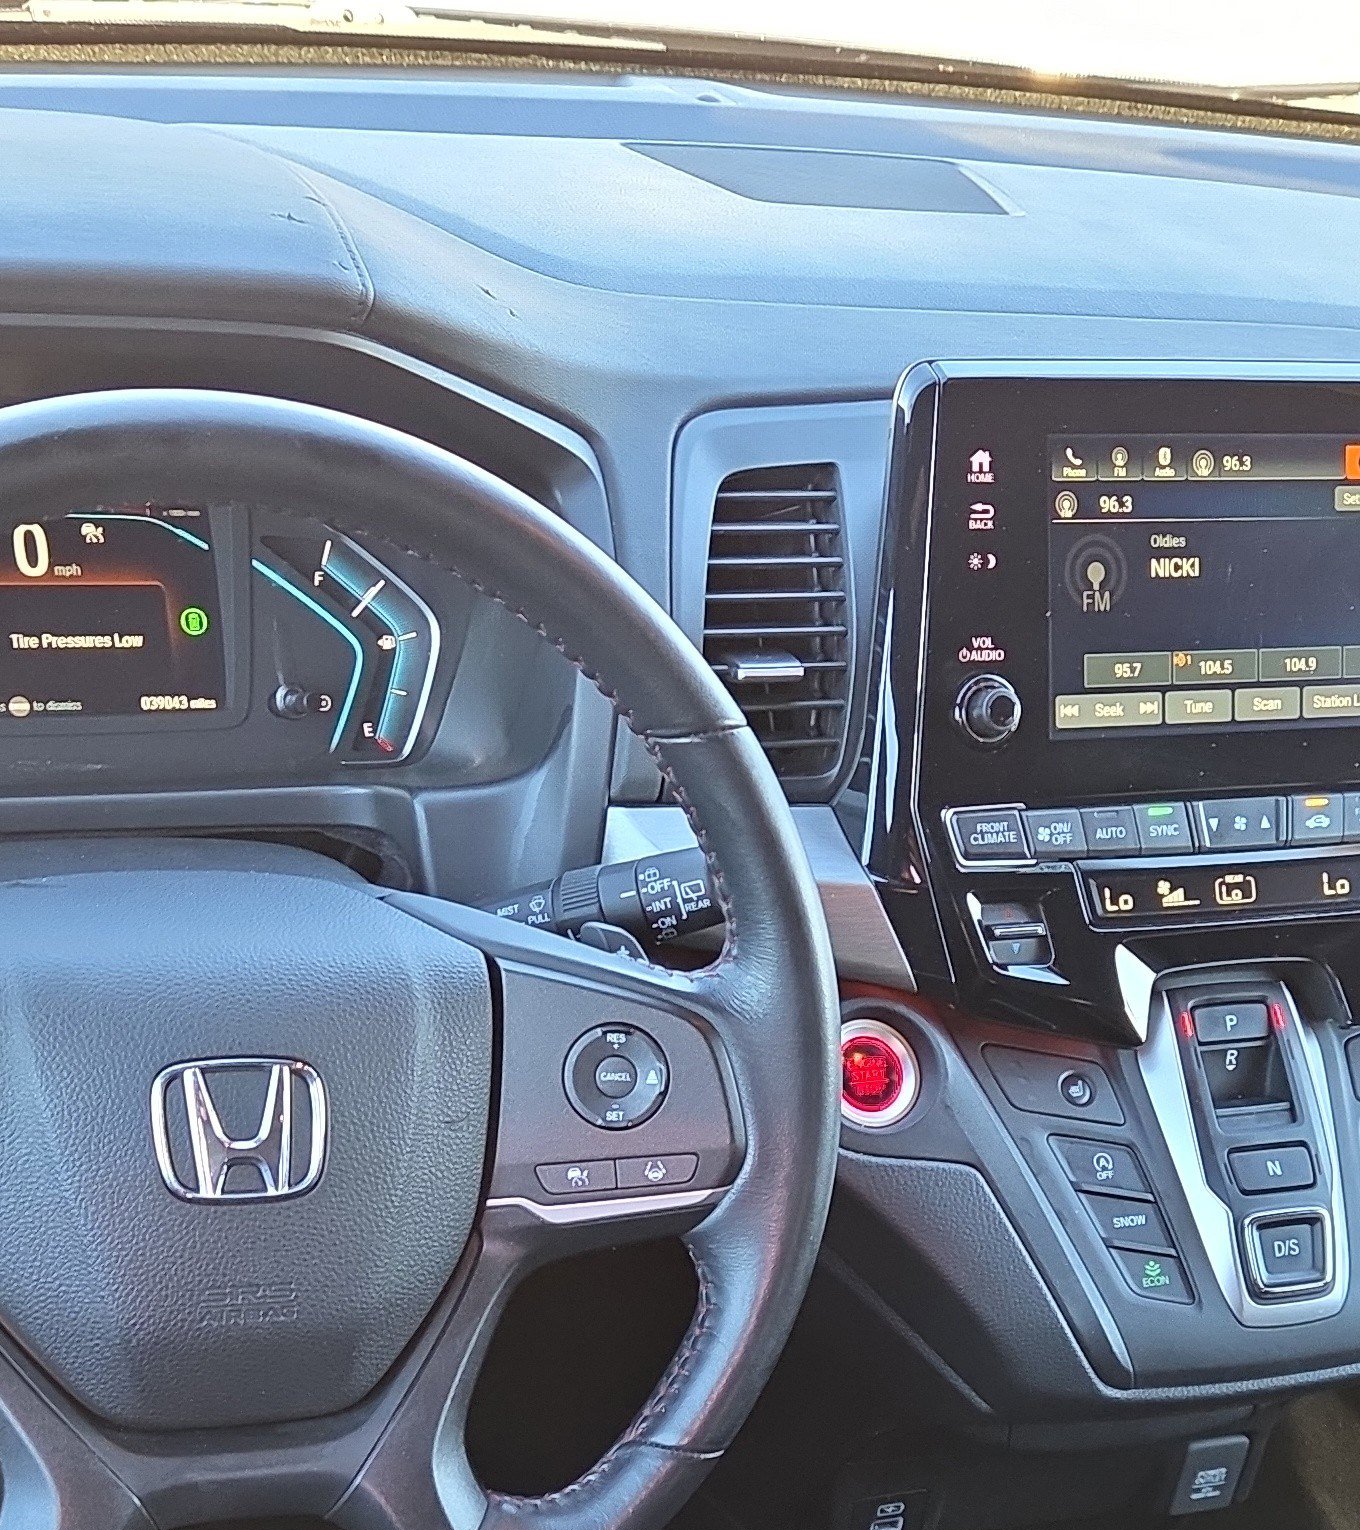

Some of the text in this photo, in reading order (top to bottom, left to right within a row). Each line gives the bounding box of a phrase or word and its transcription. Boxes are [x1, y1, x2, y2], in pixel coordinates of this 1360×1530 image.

[1222, 455, 1252, 471] 96.3
[967, 473, 994, 483] HOME
[1062, 467, 1087, 477] Phone
[1114, 467, 1127, 477] FM
[1155, 467, 1176, 477] Audio
[1099, 495, 1133, 513] 96.3
[969, 520, 994, 530] BACK
[1150, 535, 1187, 548] Oldies
[12, 523, 51, 577] 0
[54, 564, 82, 578] mph
[1150, 557, 1200, 579] NICKI
[313, 571, 324, 586] F
[1082, 590, 1111, 612] FM
[10, 633, 143, 648] Tire Pressures Low
[971, 637, 994, 648] VOL
[970, 649, 1005, 661] AUDIO
[1114, 663, 1142, 678] 95.7
[1199, 660, 1233, 675] 104.5
[1284, 657, 1317, 672] 104.9
[33, 700, 44, 711] to
[141, 695, 188, 711] 039043
[1184, 699, 1213, 714] Tune
[1253, 697, 1282, 711] Scan
[1313, 694, 1352, 709] Station
[1094, 702, 1124, 718] Seek
[362, 722, 374, 737] E
[977, 822, 1009, 834] FRONT
[1051, 822, 1072, 834] ON/
[1095, 827, 1127, 840] AUTO
[1149, 825, 1180, 838] SYNC
[970, 832, 1018, 845] CLIMATE
[1052, 833, 1073, 846] OFF
[648, 878, 671, 894] OFF
[1322, 871, 1350, 896] Lo
[1221, 884, 1243, 900] Lo
[652, 899, 673, 912] INT
[685, 899, 712, 912] REAR
[1104, 886, 1135, 913] Lo
[528, 913, 550, 925] PULL
[657, 916, 676, 929] ON
[1225, 1015, 1238, 1032] P
[606, 1033, 626, 1044] RES
[1225, 1049, 1238, 1065] R
[600, 1072, 631, 1083] CANCEL
[850, 1069, 886, 1081] START
[605, 1111, 625, 1122] SET
[1266, 1160, 1283, 1176] N
[1096, 1170, 1115, 1181] OFF
[1113, 1214, 1146, 1228] SNOW
[1273, 1239, 1300, 1258] D/S
[1142, 1275, 1170, 1288] ECON
